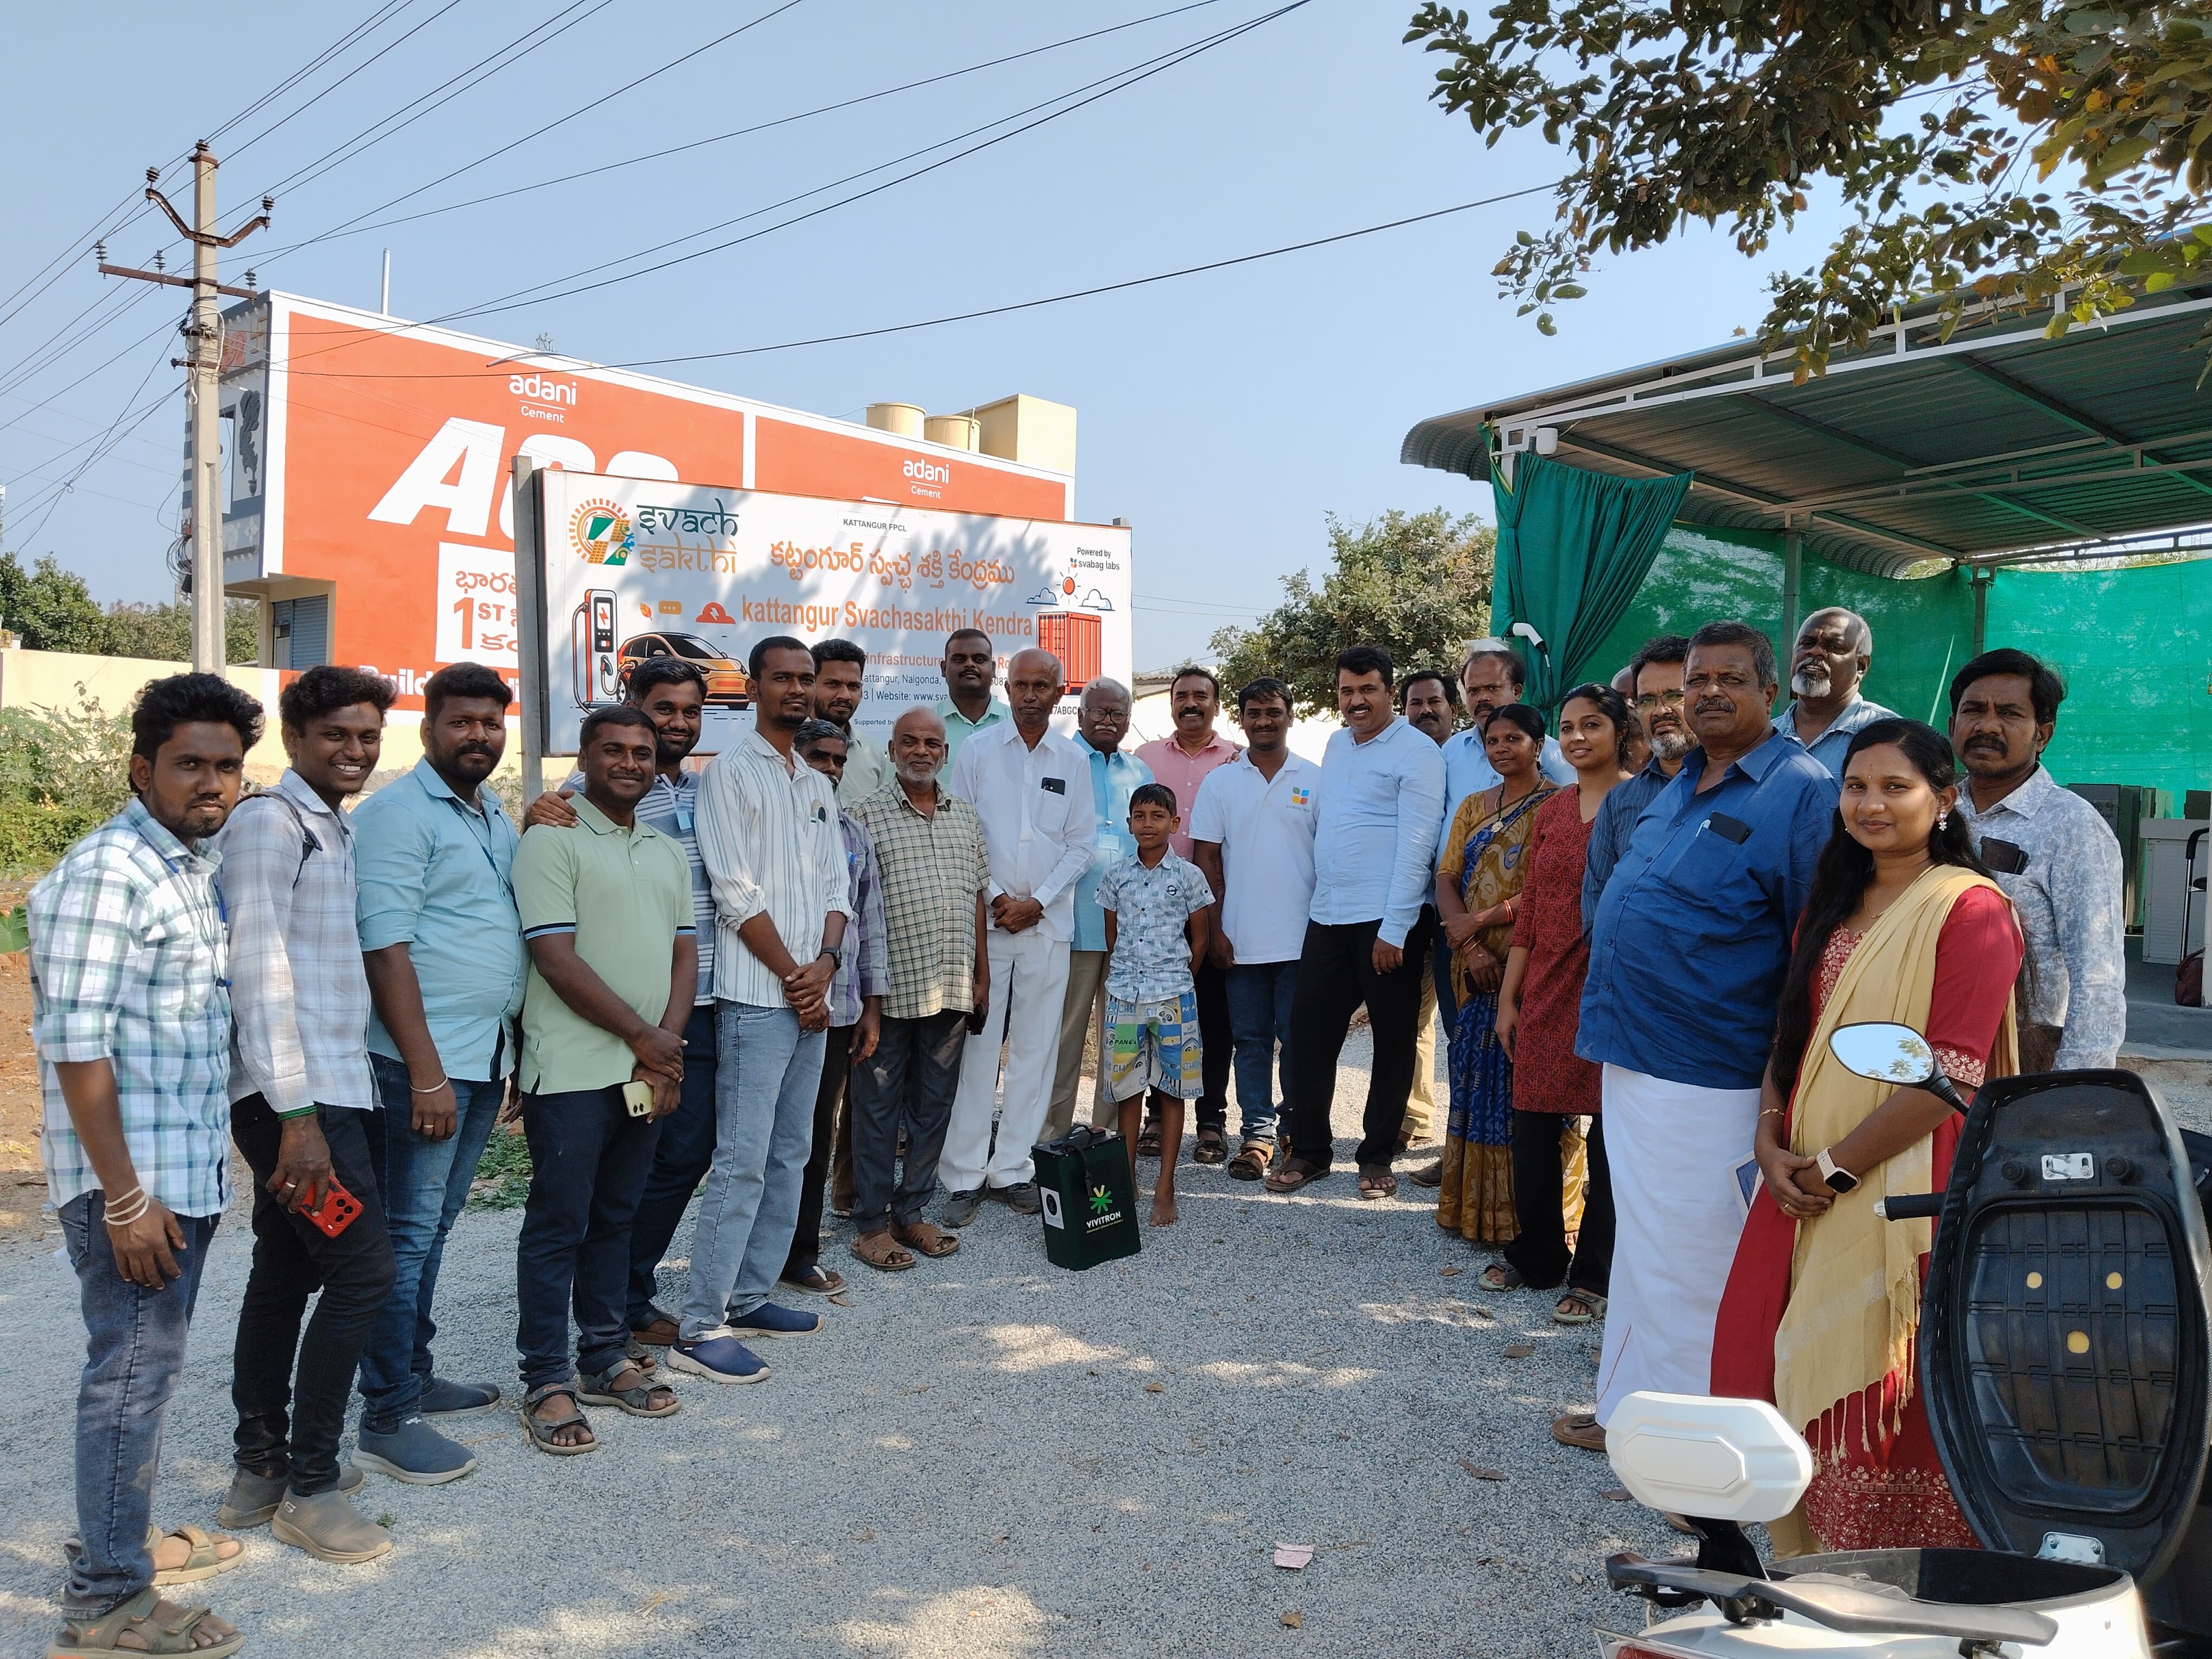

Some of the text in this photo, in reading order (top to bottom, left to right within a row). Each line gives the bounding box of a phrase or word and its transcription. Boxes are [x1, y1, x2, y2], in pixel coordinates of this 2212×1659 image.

[509, 374, 577, 406] adani
[521, 406, 565, 423] Cement
[903, 459, 949, 484] adani
[911, 485, 941, 499] Cement
[637, 498, 739, 536] svach
[843, 519, 907, 532] KATTANGUR FPCL
[638, 532, 737, 574] sakthi
[1077, 547, 1111, 559] Powered by
[770, 540, 1015, 594] కట్టంగూర్ స్వచ్ఛ శక్తి కేంద్రము
[1078, 560, 1120, 571] svabag labs
[743, 594, 1032, 636] kattangur Svachasakthi Kendra
[861, 674, 899, 685] attangur,
[902, 675, 941, 686] Nalgonda,
[876, 691, 911, 700] Website:
[1086, 1211, 1121, 1228] VIVITRON
